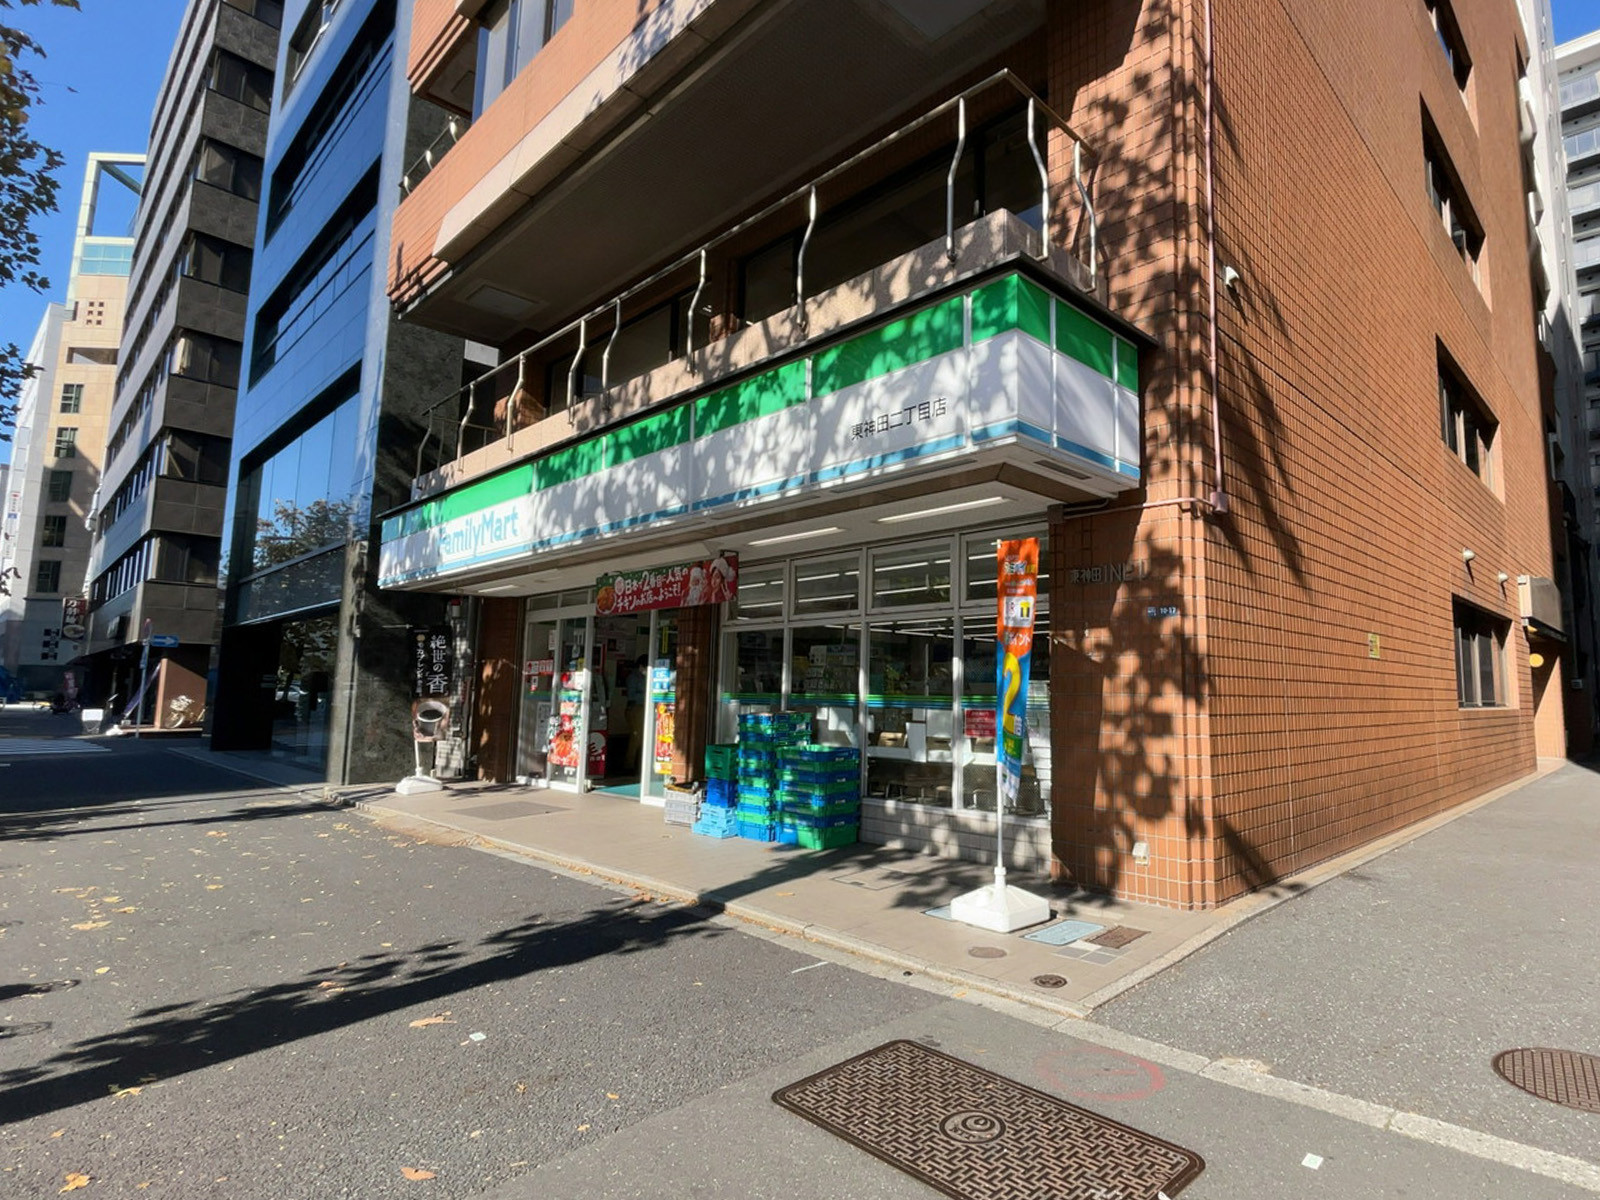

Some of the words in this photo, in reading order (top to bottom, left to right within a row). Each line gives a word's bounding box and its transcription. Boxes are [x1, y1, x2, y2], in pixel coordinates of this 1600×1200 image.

[850, 397, 947, 441] 東神田二丁目店
[437, 507, 519, 556] FamilyMart
